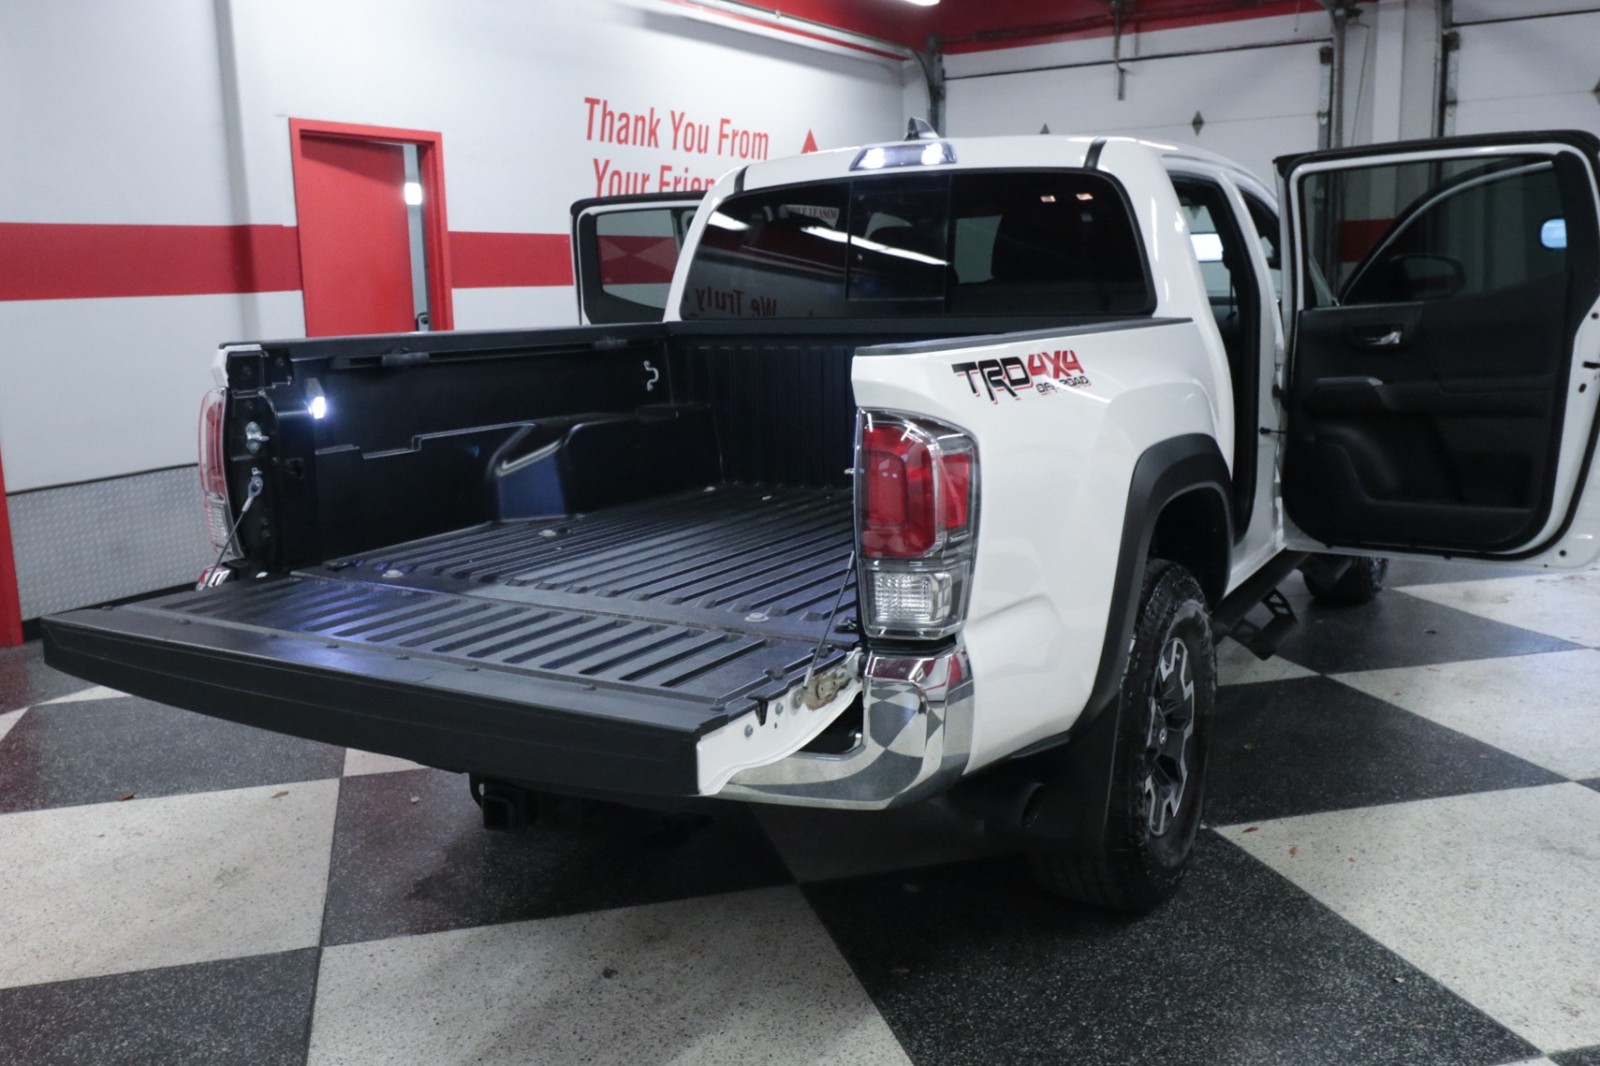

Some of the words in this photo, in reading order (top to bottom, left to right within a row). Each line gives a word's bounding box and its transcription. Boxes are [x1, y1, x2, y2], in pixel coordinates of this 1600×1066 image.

[584, 97, 661, 148] Thank
[670, 110, 709, 154] You
[717, 118, 769, 160] From
[593, 158, 650, 198] Your
[951, 356, 1034, 404] TRD
